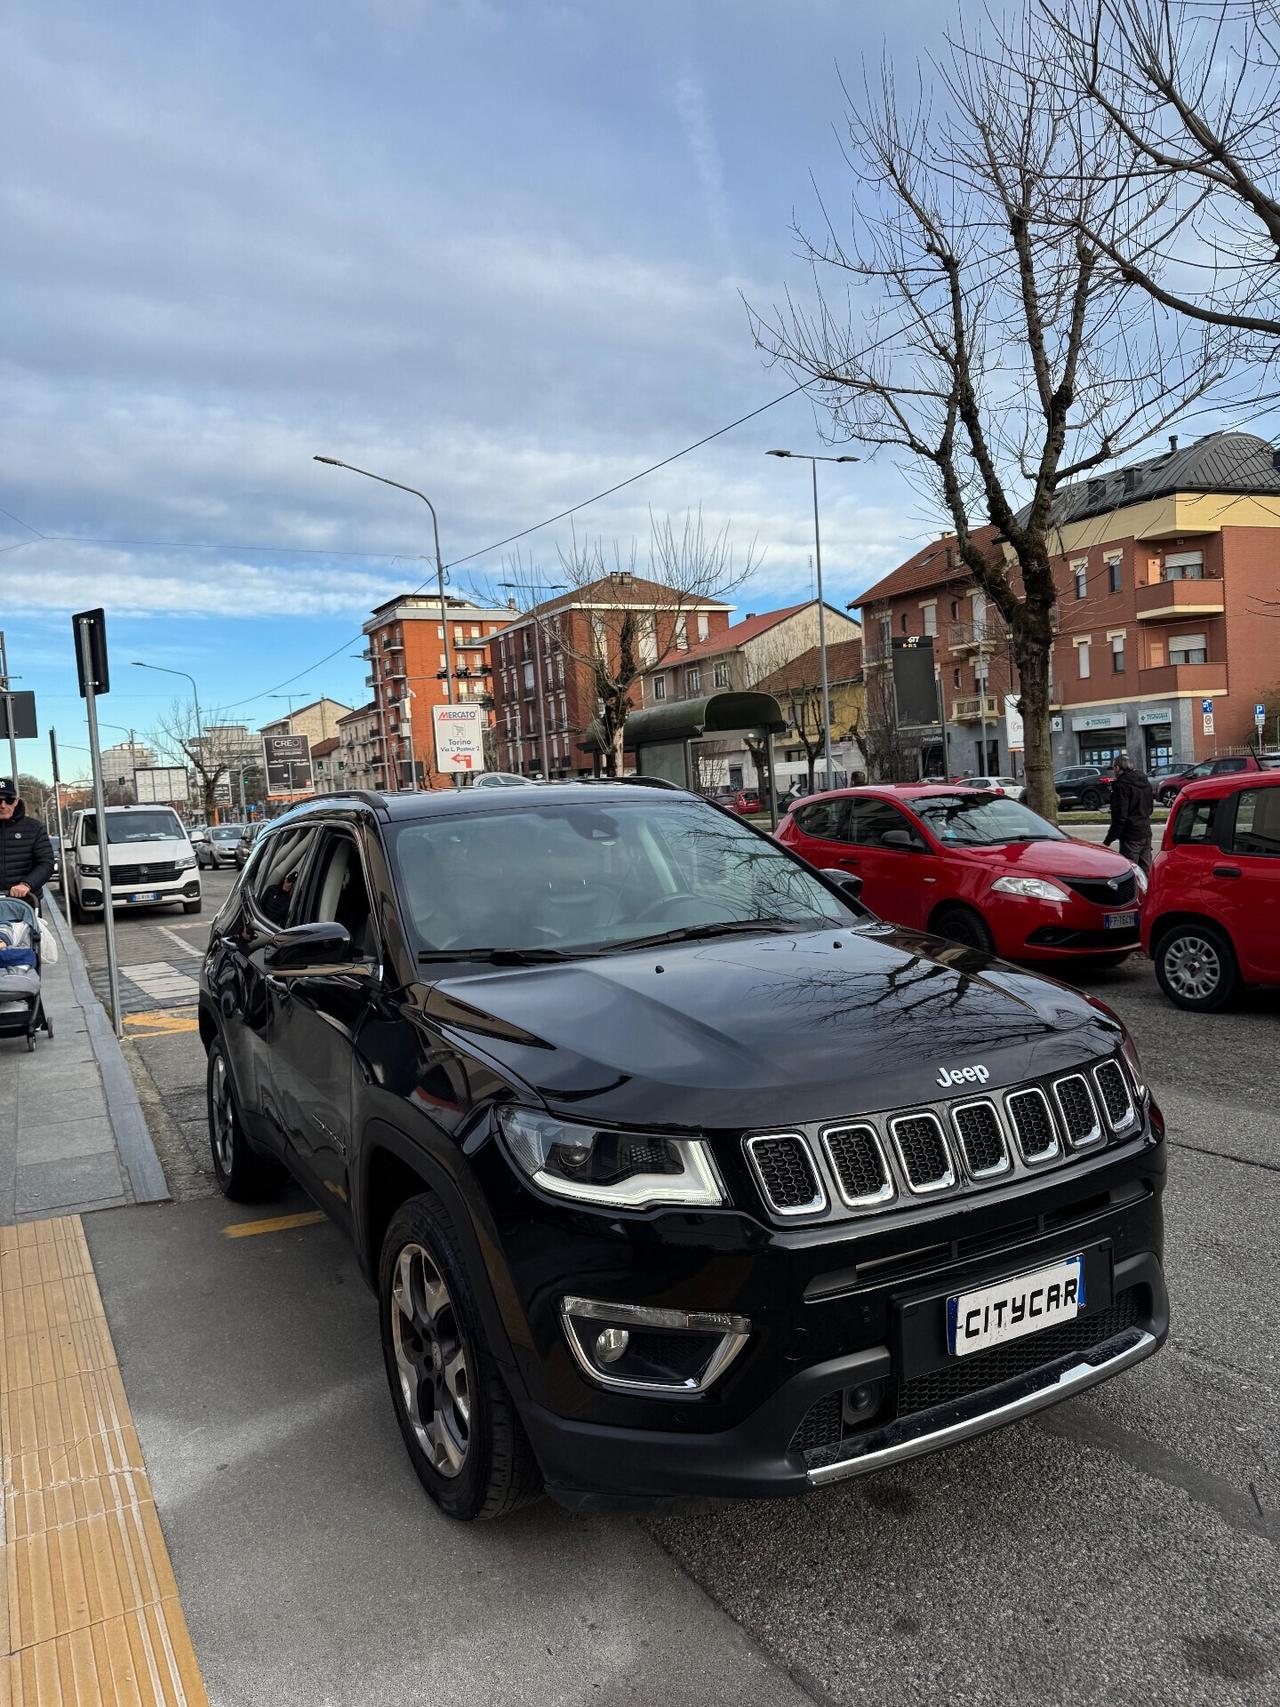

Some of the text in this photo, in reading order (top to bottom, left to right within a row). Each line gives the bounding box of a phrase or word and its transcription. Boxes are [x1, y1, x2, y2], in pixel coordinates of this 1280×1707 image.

[1256, 705, 1263, 714] P
[438, 711, 476, 720] MERCATO
[274, 739, 300, 748] CREO
[448, 738, 472, 746] Torino
[936, 1064, 990, 1088] Jeep
[964, 1278, 1078, 1340] CITYCAR
